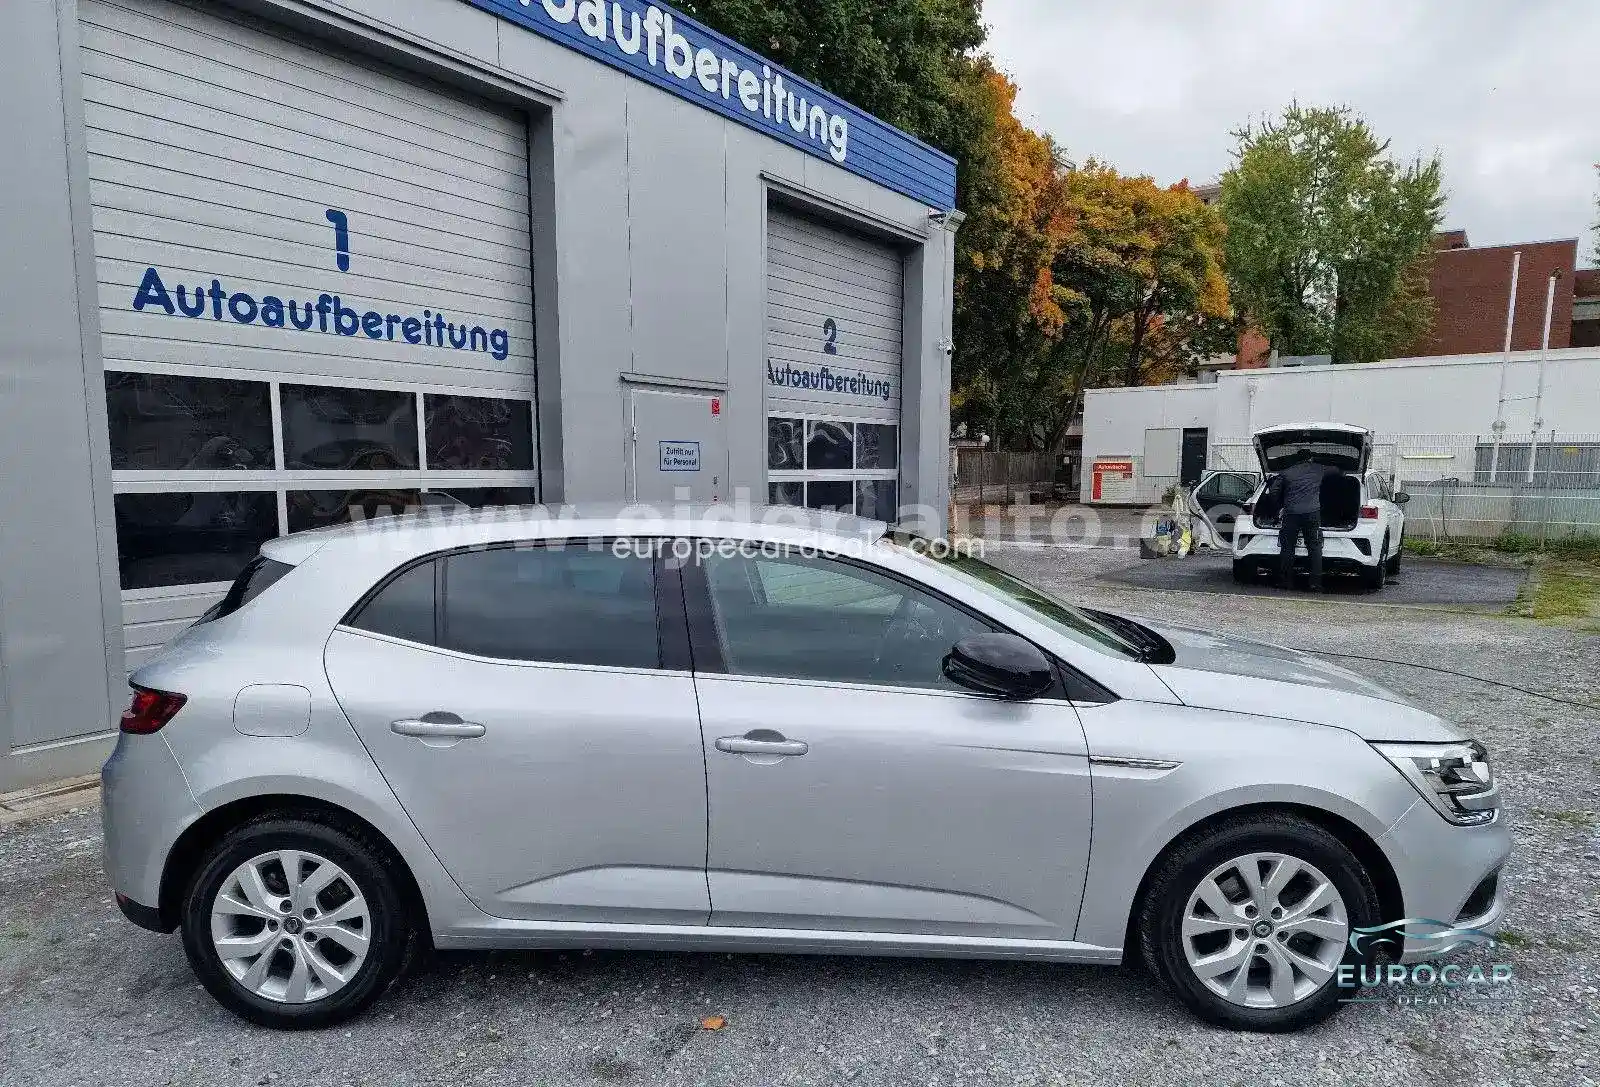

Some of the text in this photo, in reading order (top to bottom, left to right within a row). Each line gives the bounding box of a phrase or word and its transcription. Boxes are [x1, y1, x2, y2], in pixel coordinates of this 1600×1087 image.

[325, 209, 350, 272] 1
[132, 267, 510, 361] Autoaufbereitung
[823, 318, 837, 355] 2
[663, 458, 697, 466] für Personal
